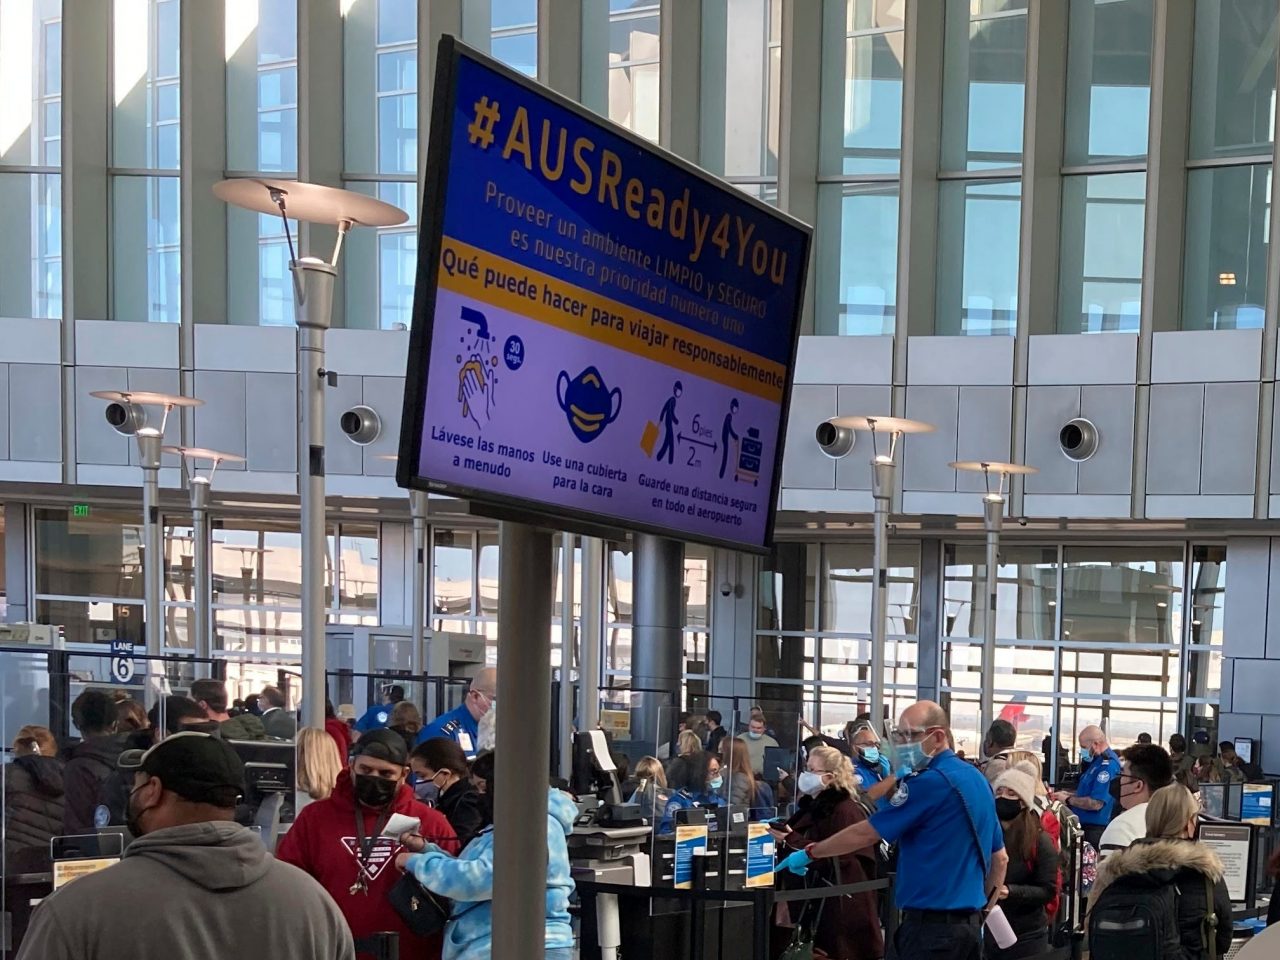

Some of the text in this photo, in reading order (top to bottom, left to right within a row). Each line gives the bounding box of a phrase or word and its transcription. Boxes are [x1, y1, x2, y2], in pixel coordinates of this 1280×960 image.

[468, 96, 787, 286] #AUSReady4You
[485, 180, 767, 319] Proveer un ambiente LIMPIO y SEGURO
[510, 228, 529, 251] es
[534, 238, 596, 277] nuestra
[600, 264, 667, 304] prioridad
[722, 316, 745, 337] uno
[442, 248, 784, 390] Qué puede hacer para viajar responsablemente
[510, 340, 520, 354] 30
[692, 413, 700, 434] 6
[431, 425, 535, 463] Lávese las manos
[687, 446, 696, 466] 2
[452, 454, 512, 479] a menudo
[542, 450, 628, 483] Use una cubierta
[552, 474, 614, 498] para la cara
[638, 473, 757, 512] Guarde una distancia segura
[73, 505, 89, 517] EXIT
[651, 497, 742, 526] en todo el aeropuerto
[113, 642, 133, 651] LANE
[117, 653, 129, 679] 6
